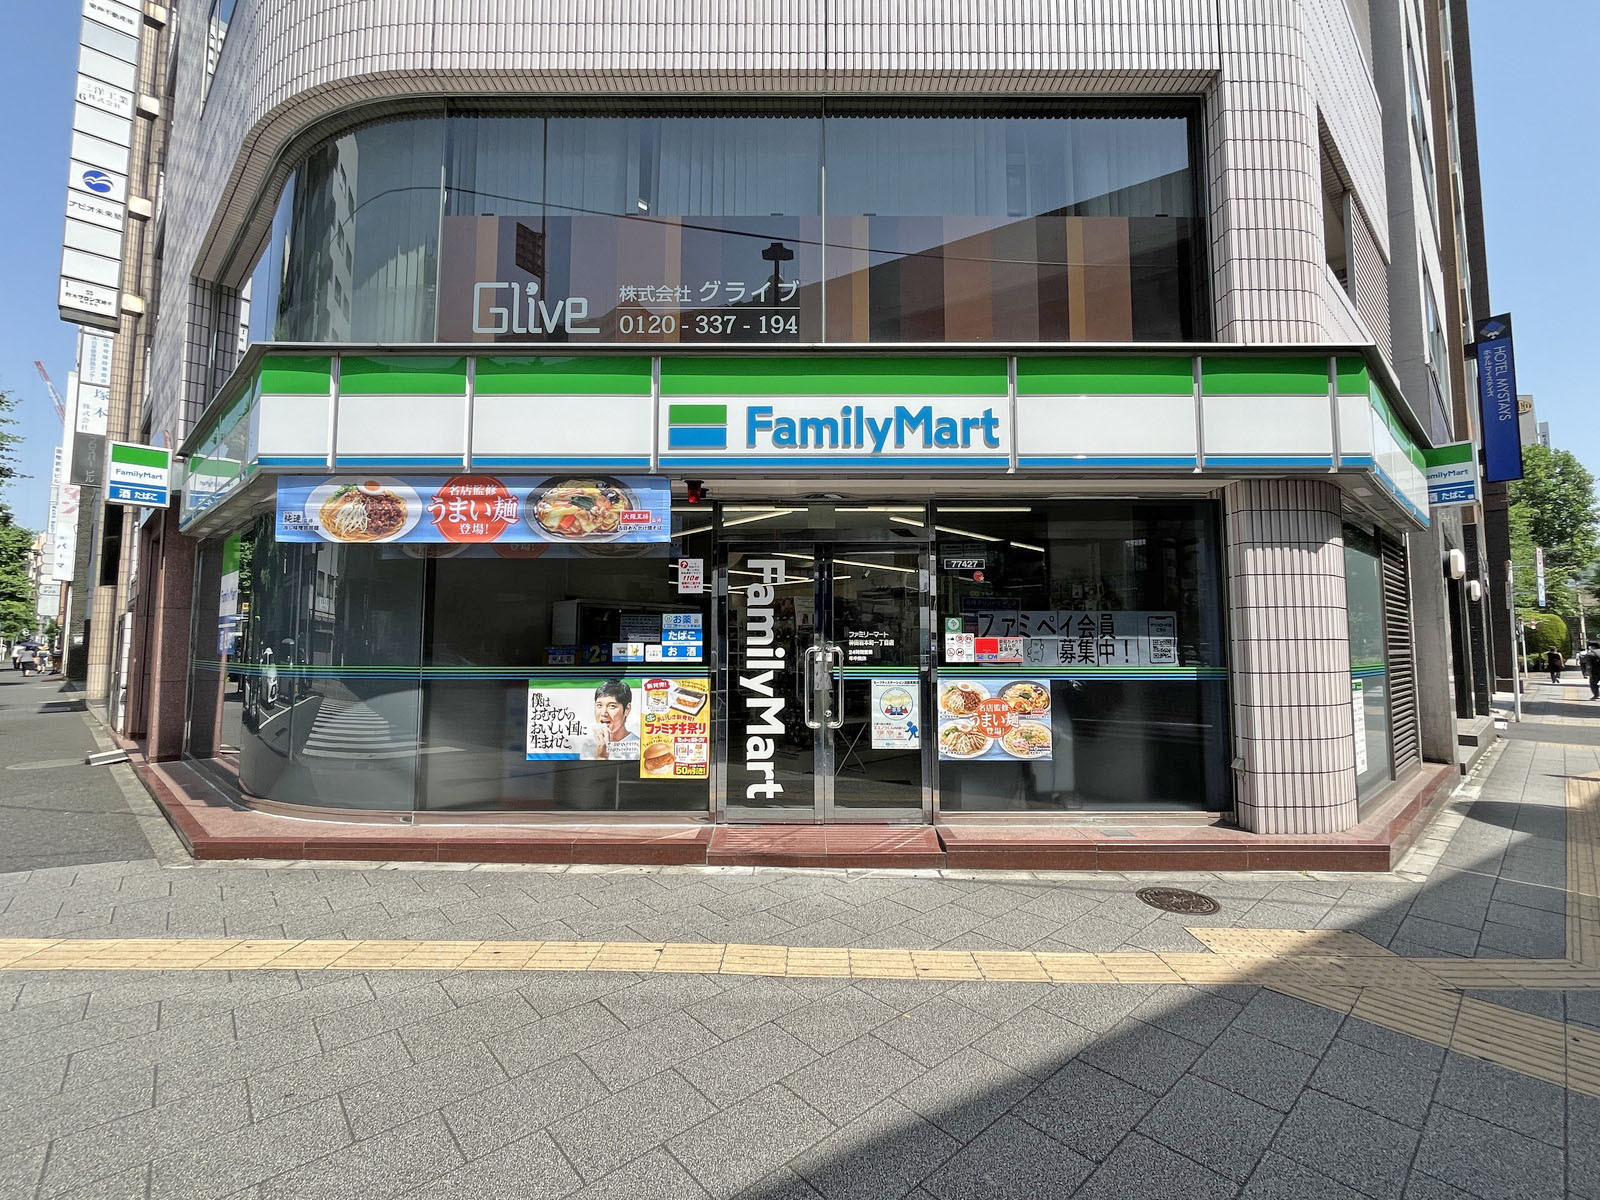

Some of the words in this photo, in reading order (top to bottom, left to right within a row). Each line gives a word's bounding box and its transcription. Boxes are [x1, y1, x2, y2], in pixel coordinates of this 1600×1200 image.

[619, 284, 692, 303] 株式会社
[699, 280, 800, 303] グライブ
[472, 282, 600, 335] Glive
[1493, 345, 1508, 377] HOTEL
[1497, 377, 1512, 422] MYSTAYS
[746, 405, 1001, 454] FamilyMart
[115, 468, 163, 480] FamilyMart
[1426, 469, 1469, 480] amilyMart
[118, 488, 131, 499] 酒
[134, 491, 158, 501] たばこ
[449, 484, 497, 496] 名店監修
[1441, 490, 1466, 501] たばこ
[426, 496, 521, 525] うまい麺
[458, 523, 490, 535] 登場!
[951, 560, 978, 568] 77427
[672, 615, 692, 624] お薬
[978, 613, 1117, 639] ファミペイ会員
[667, 630, 697, 641] たばこ
[1059, 639, 1130, 664] 募集中!
[739, 559, 786, 799] FamilyMart
[532, 693, 550, 708] 僕は
[980, 703, 1009, 712] 名店監修
[531, 707, 576, 722] おむすびの
[968, 711, 1020, 728] うまい麺
[531, 721, 588, 736] おいしい国に
[645, 722, 706, 735] ファミチキ祭り
[986, 727, 1005, 735] 登場!
[530, 734, 573, 750] 生まれた。
